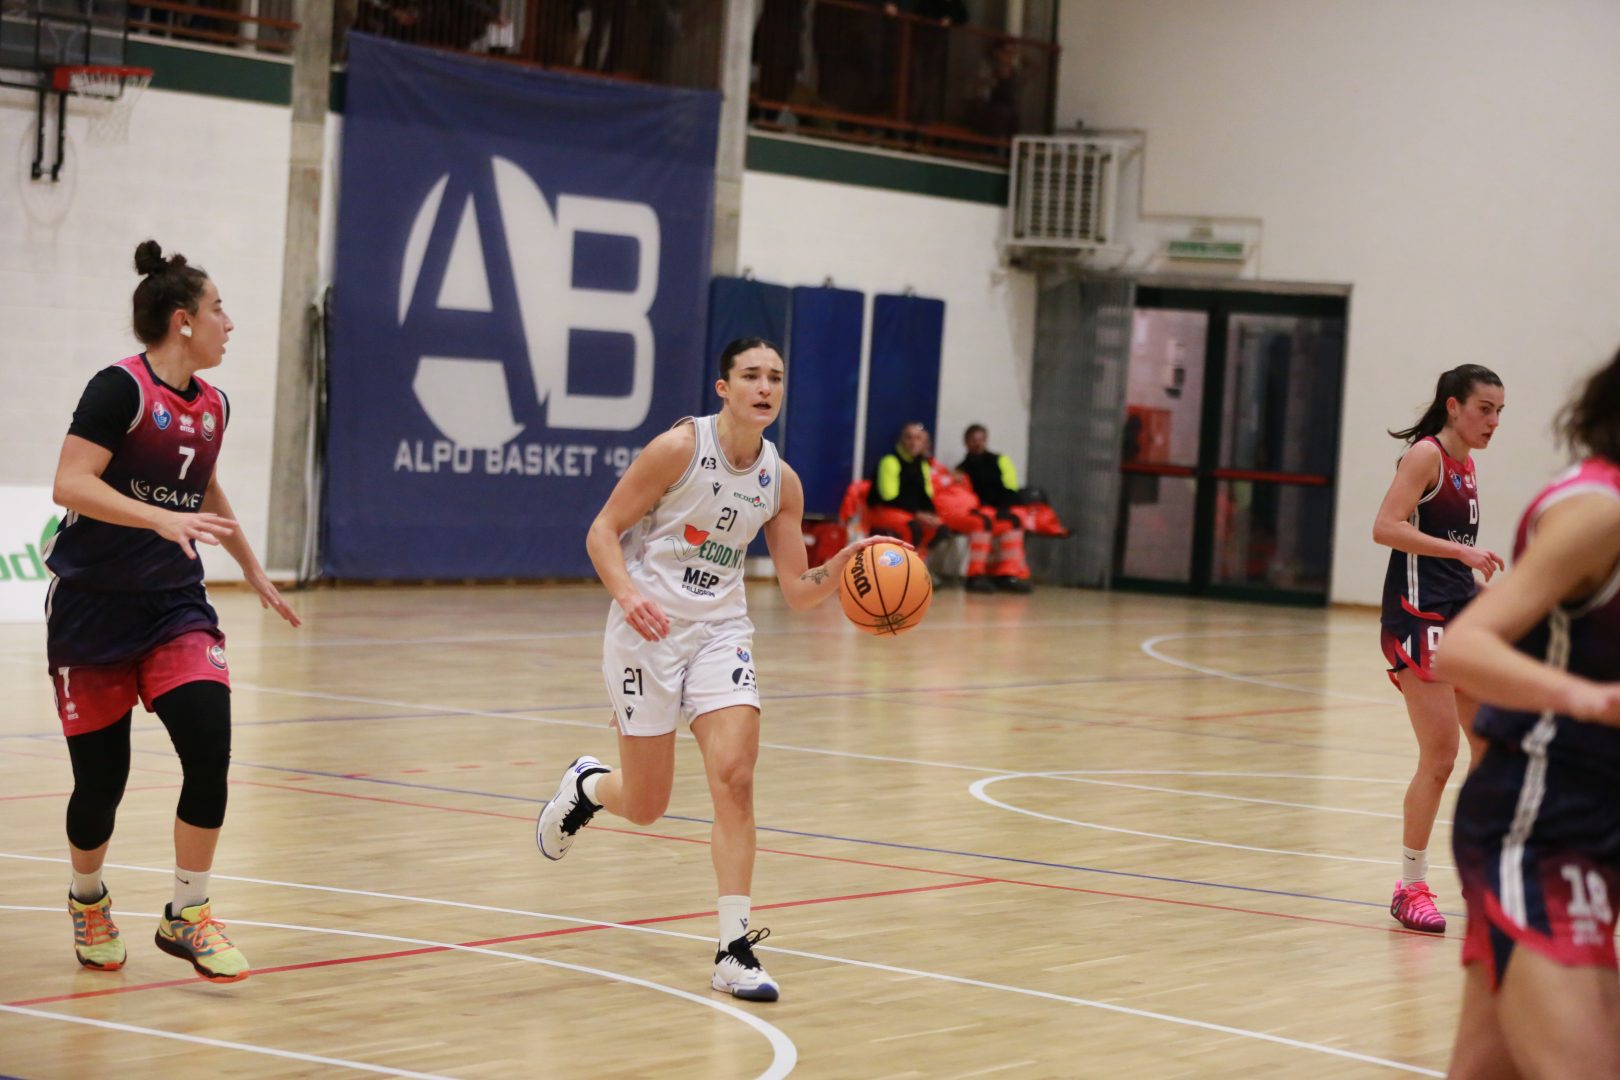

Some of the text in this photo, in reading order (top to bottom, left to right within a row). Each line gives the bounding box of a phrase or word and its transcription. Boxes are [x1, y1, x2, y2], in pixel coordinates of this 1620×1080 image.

[178, 445, 195, 480] 7
[393, 439, 473, 473] ALPO
[485, 443, 597, 477] BASKET
[716, 506, 738, 532] 21
[698, 540, 744, 570] ECODNT
[683, 567, 720, 589] MEP
[851, 551, 871, 599] Wilso
[57, 666, 71, 699] 7
[622, 666, 644, 696] 21
